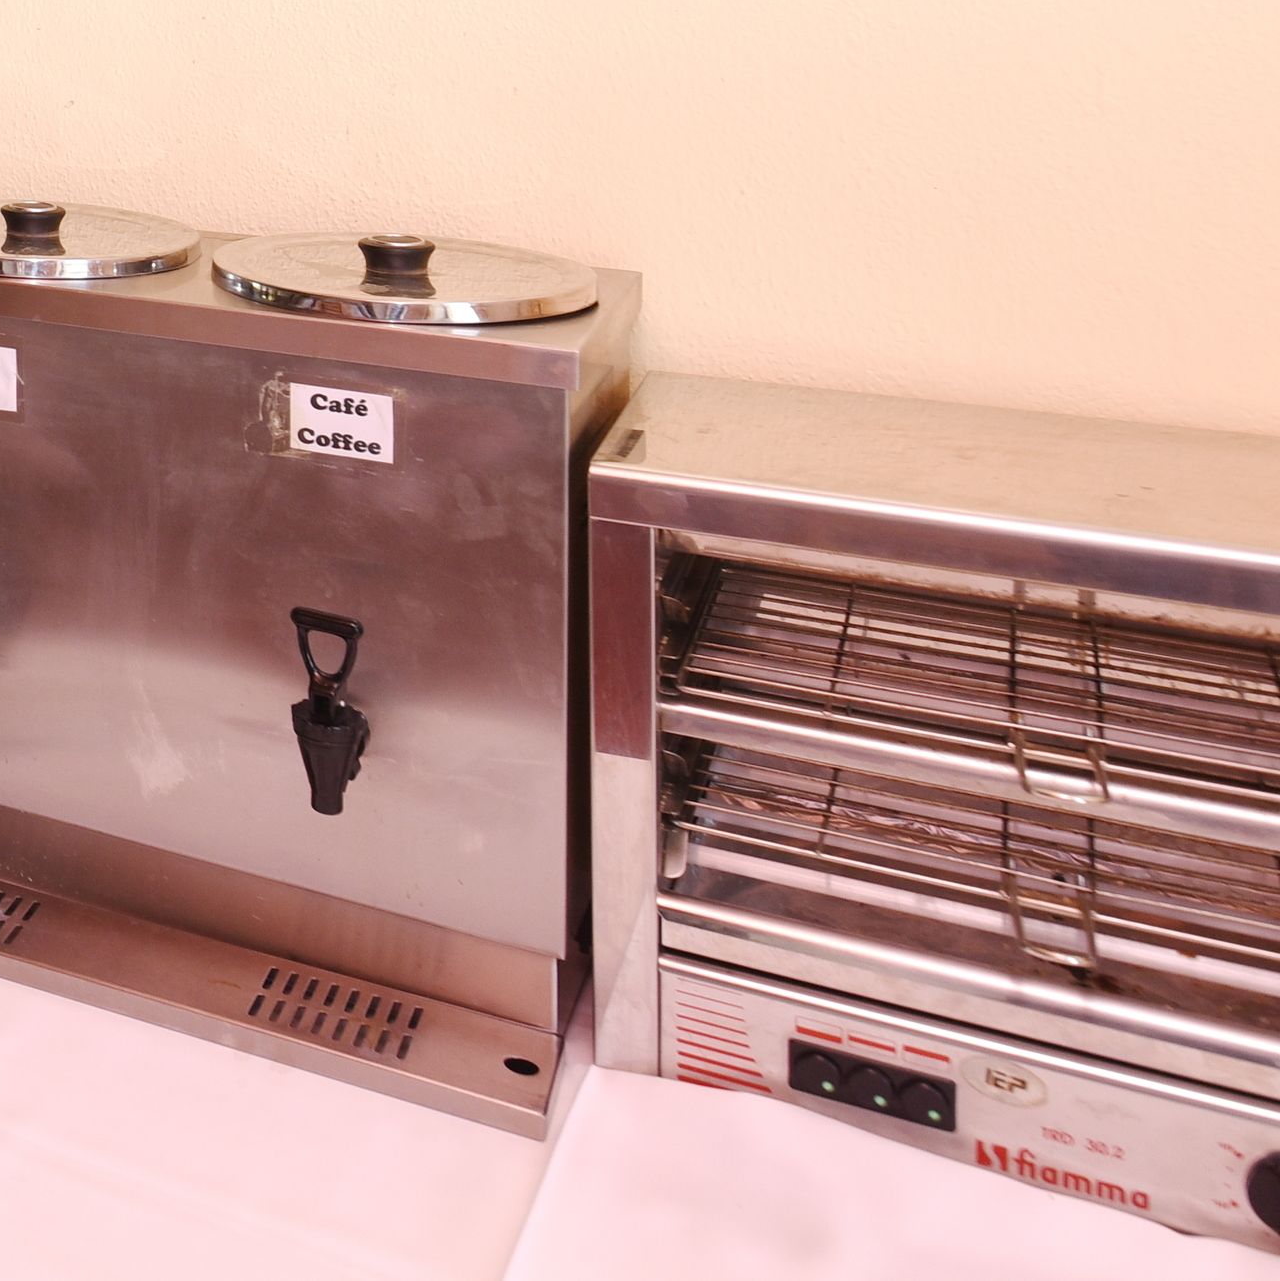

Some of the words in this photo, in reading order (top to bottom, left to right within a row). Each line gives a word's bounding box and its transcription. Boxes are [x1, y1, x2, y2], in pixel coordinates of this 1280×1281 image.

[310, 393, 368, 417] Café
[297, 427, 381, 454] Coffee
[1012, 1147, 1151, 1210] fiamma
